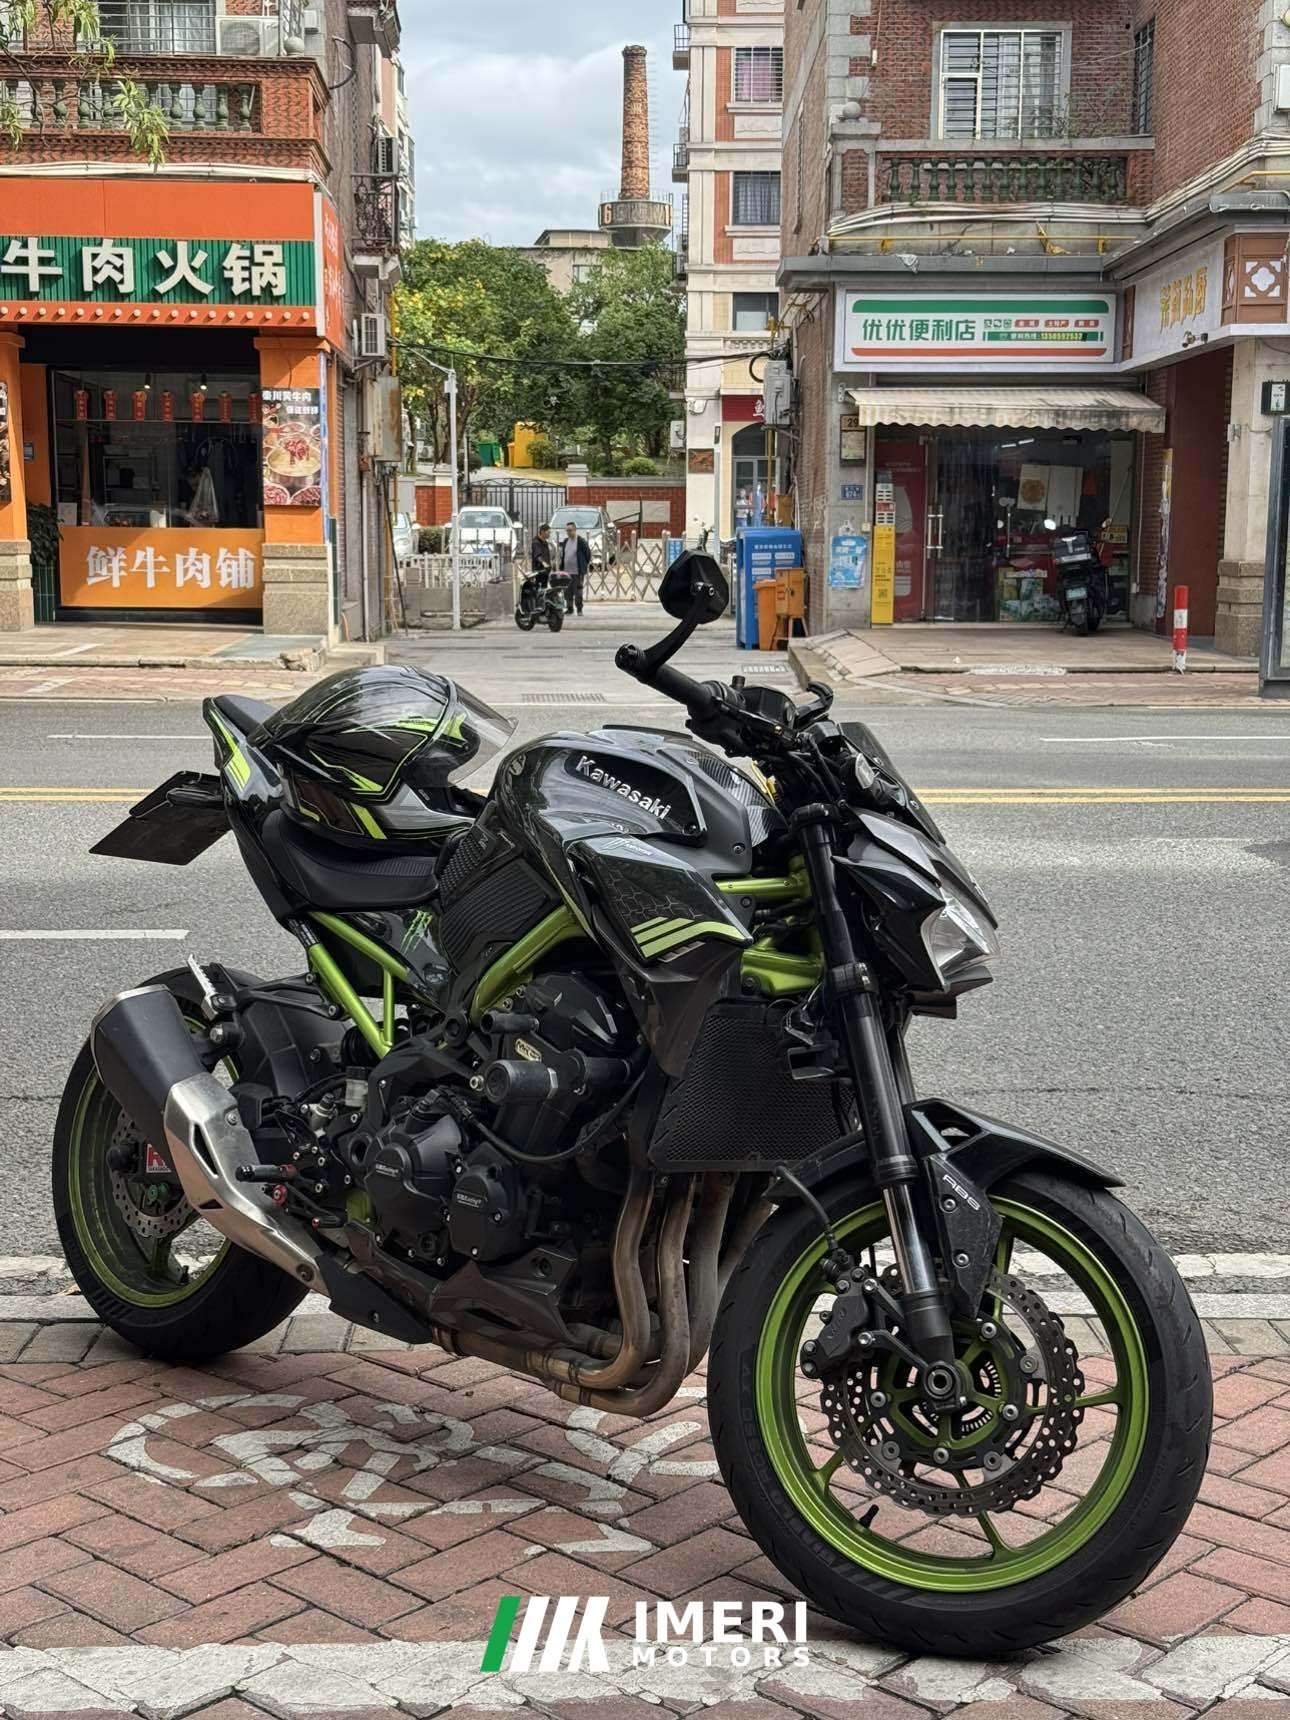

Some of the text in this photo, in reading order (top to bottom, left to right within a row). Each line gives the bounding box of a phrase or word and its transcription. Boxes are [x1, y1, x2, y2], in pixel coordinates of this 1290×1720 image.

[1, 237, 287, 296] 牛肉火锅
[862, 318, 977, 342] 优优便利店
[86, 545, 257, 589] 鲜牛肉铺
[575, 755, 672, 820] Kawasaki
[942, 1174, 981, 1211] ABS
